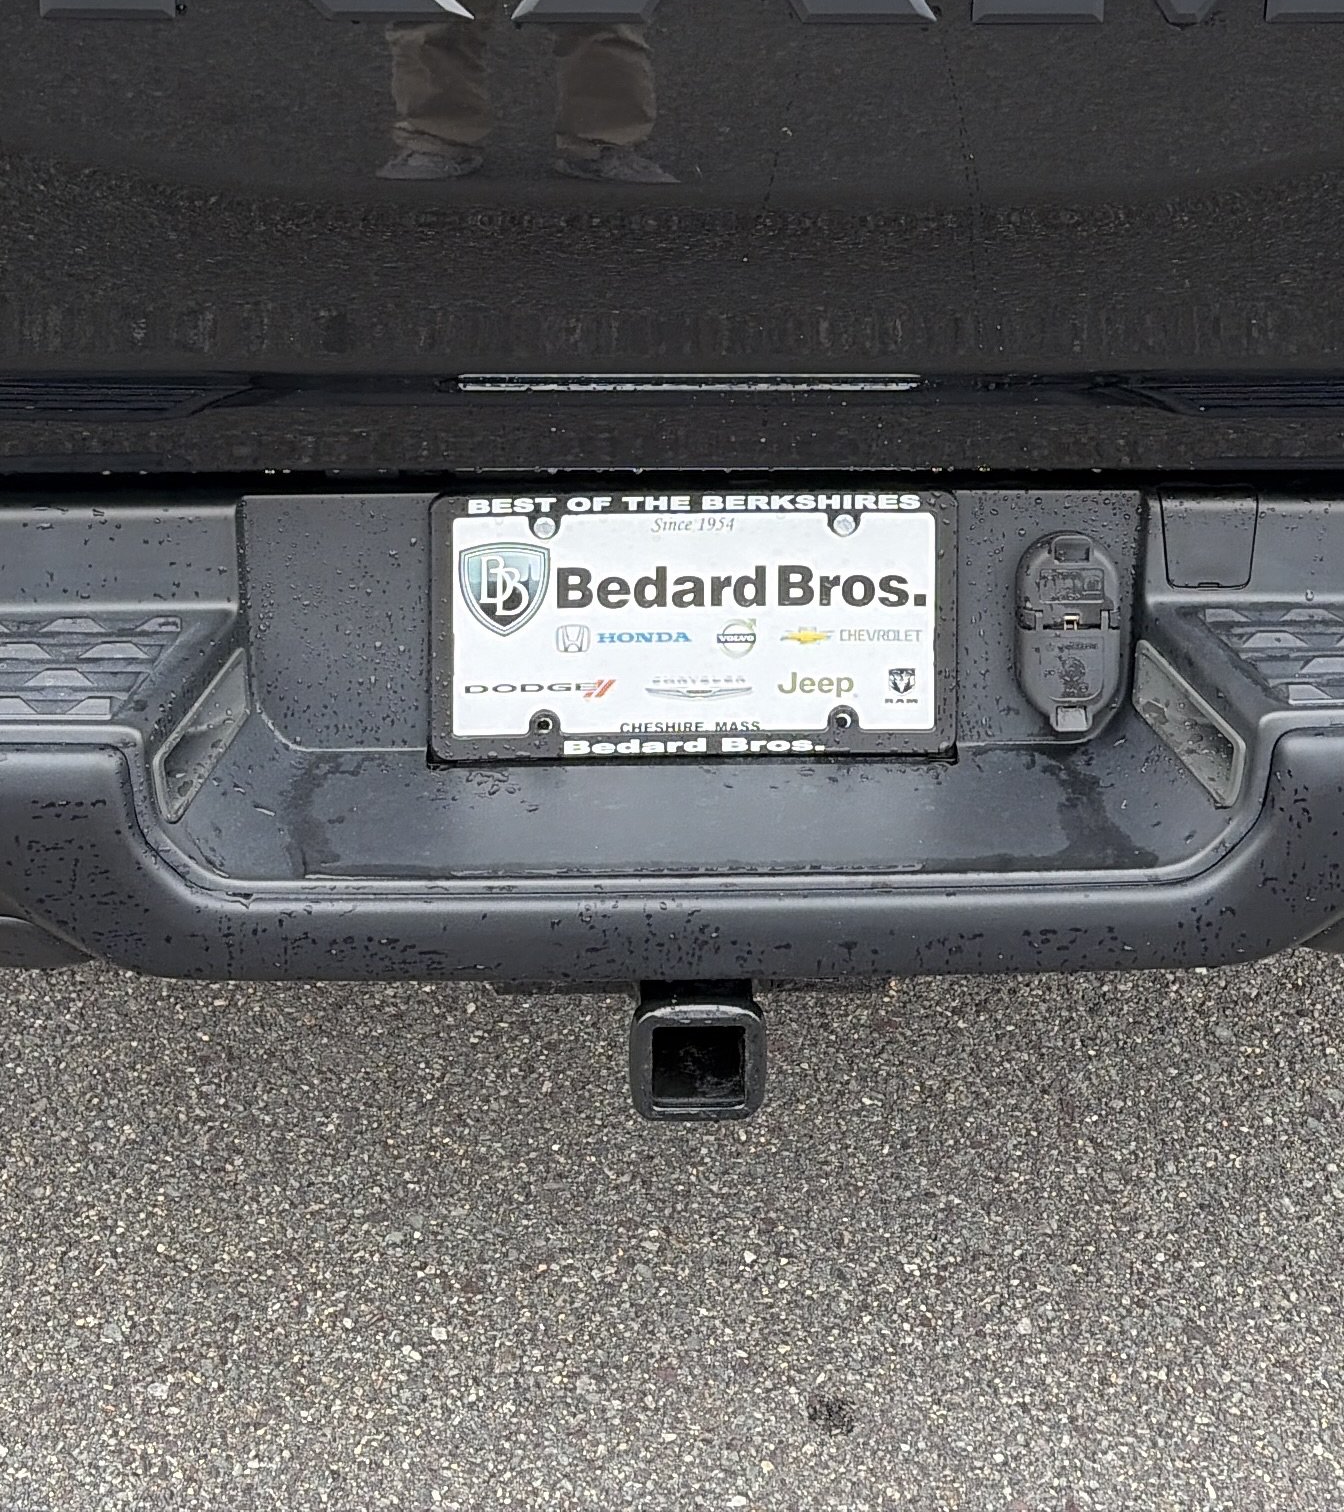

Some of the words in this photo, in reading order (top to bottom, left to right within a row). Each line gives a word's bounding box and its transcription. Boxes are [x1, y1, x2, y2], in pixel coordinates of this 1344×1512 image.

[467, 497, 557, 514] BEST
[566, 496, 611, 512] OF
[622, 496, 691, 511] THE
[701, 494, 922, 511] BERKSHIRES
[650, 516, 693, 533] Since
[697, 516, 735, 532] 1954
[556, 565, 767, 609] Bedard
[777, 564, 927, 607] Bros.
[596, 631, 692, 644] HONDA
[718, 634, 756, 643] VOLVO
[839, 629, 923, 642] CHEVROLET
[464, 682, 596, 694] DODGE
[777, 672, 854, 697] Jeep
[563, 738, 707, 754] Bedard
[721, 737, 825, 752] Bros.
